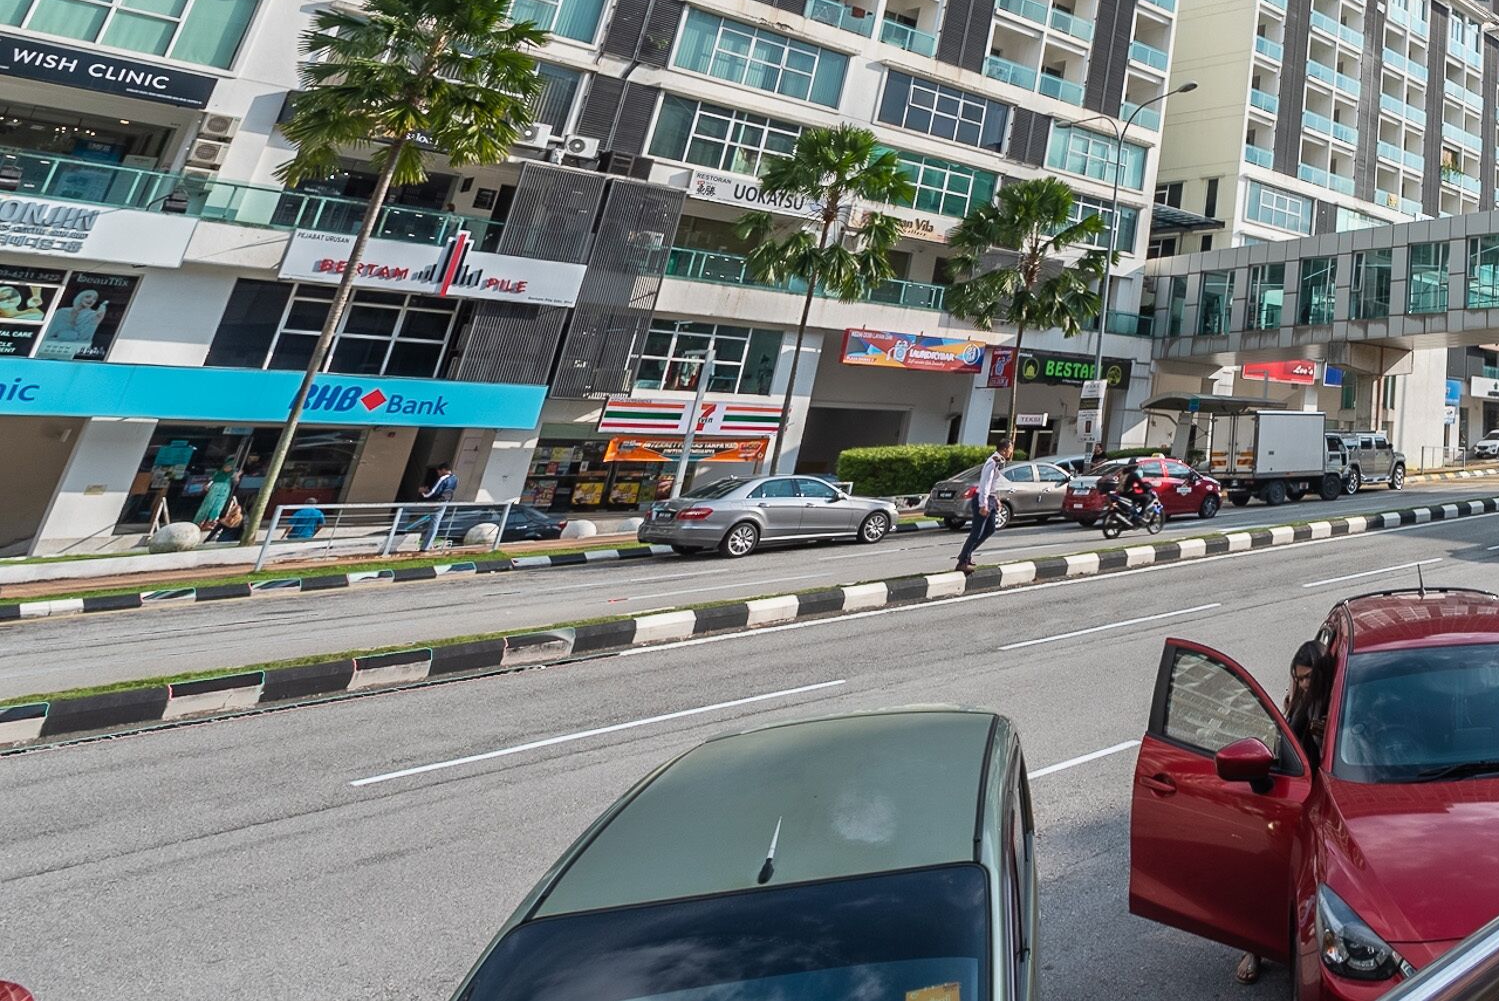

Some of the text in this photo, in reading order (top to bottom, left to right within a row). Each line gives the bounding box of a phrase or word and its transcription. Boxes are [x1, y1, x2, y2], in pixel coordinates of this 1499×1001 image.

[12, 47, 170, 90] WISH CLINIC
[696, 171, 732, 184] RESTORAN
[733, 183, 805, 211] UOKATSU
[296, 231, 350, 244] PEJABAT URUSAN
[316, 257, 529, 294] BERTAM PILE
[1045, 360, 1103, 379] BESTAR
[289, 384, 449, 416] RHB Bank
[695, 404, 717, 431] 7
